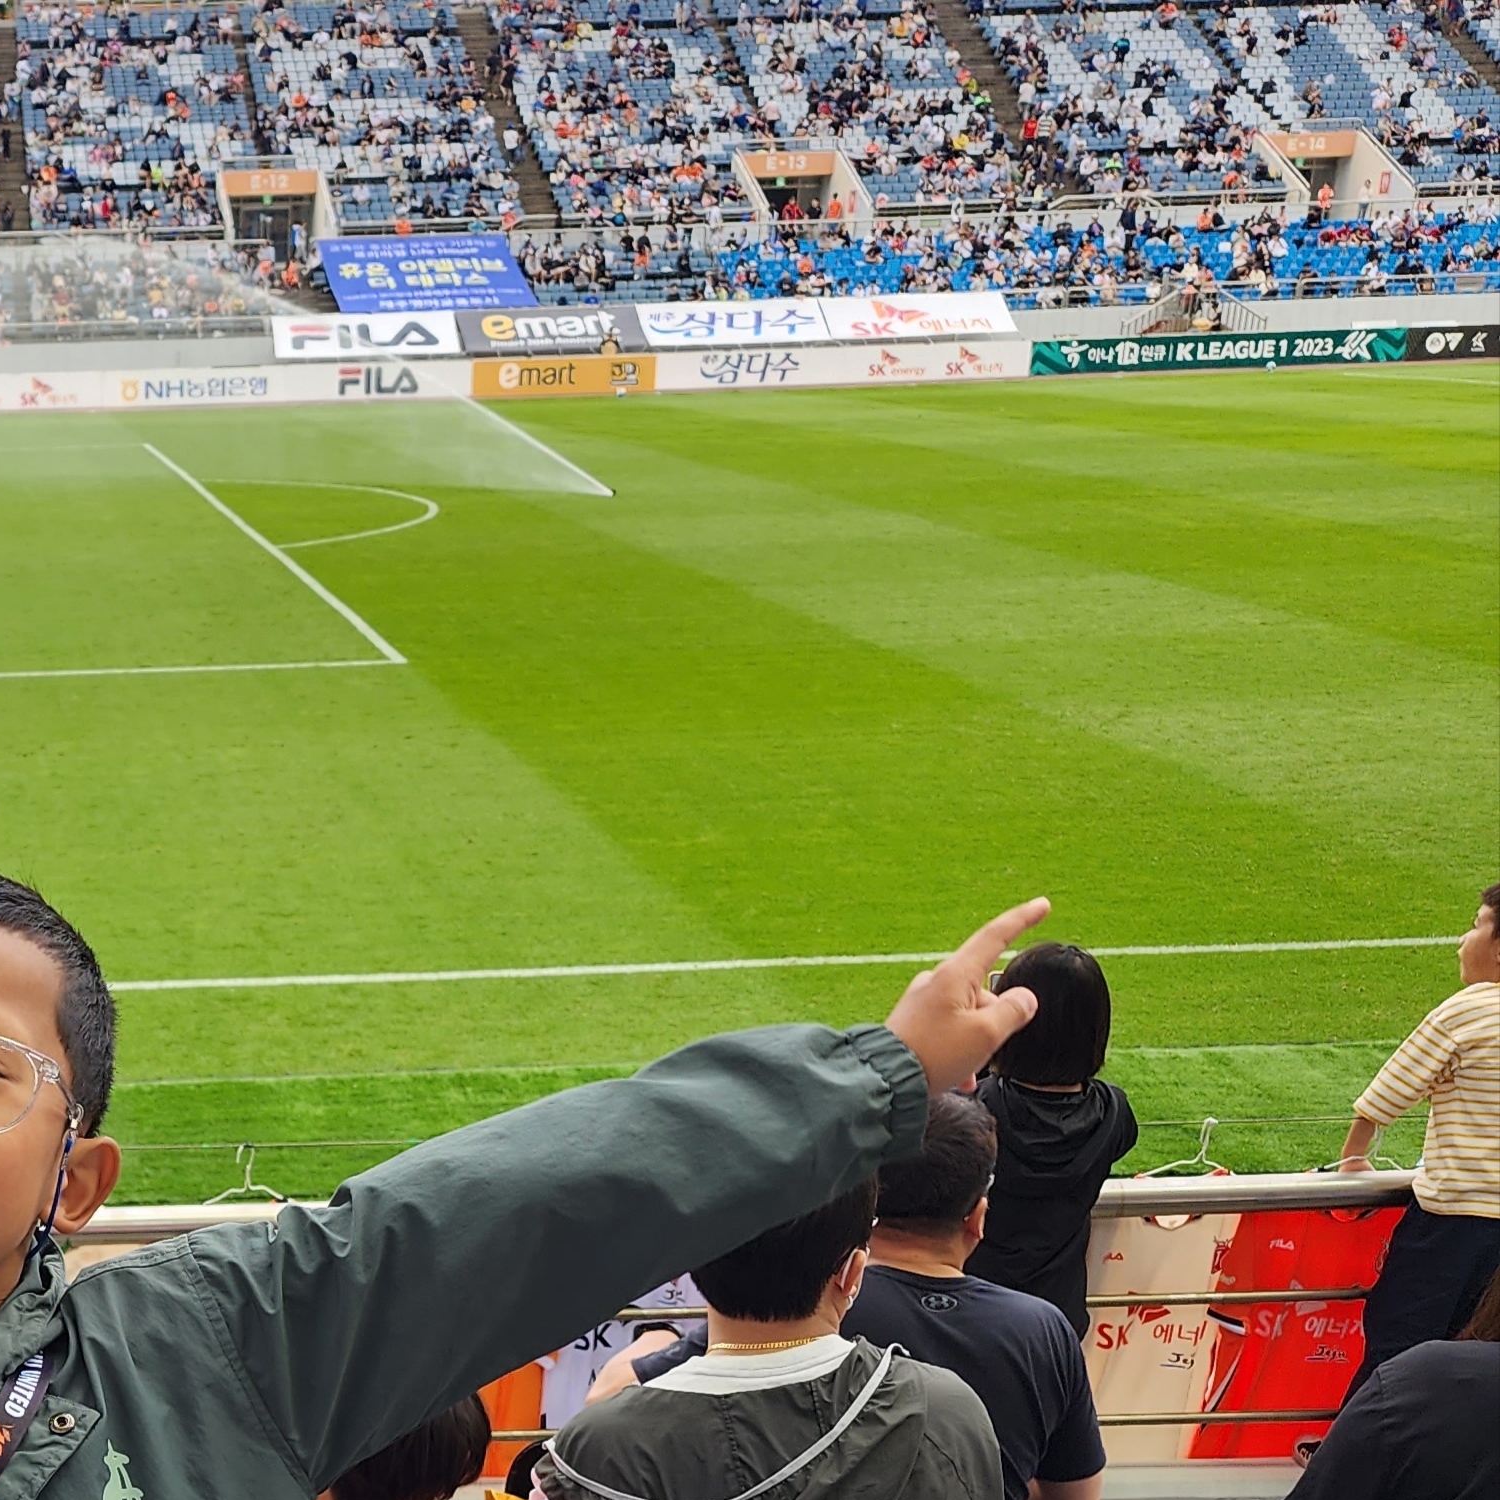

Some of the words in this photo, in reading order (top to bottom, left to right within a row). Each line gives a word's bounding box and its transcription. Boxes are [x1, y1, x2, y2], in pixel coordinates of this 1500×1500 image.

[766, 155, 807, 171] E-13
[289, 321, 440, 350] FILA
[481, 311, 616, 341] emart
[678, 309, 816, 338] 삼다수
[851, 321, 899, 337] SK
[919, 316, 993, 332] 에너지
[1175, 342, 1195, 361] K
[1197, 340, 1276, 360] LEAGUE
[1293, 337, 1334, 357] 2023
[338, 366, 419, 395] FILA
[499, 362, 576, 389] emart
[713, 352, 799, 384] 삼다수
[868, 364, 886, 376] SK
[945, 362, 965, 375] SK
[144, 377, 268, 399] NH농협은행
[1096, 1321, 1135, 1350] SK
[1255, 1309, 1290, 1339] SK
[4, 1370, 41, 1418] UNITED
